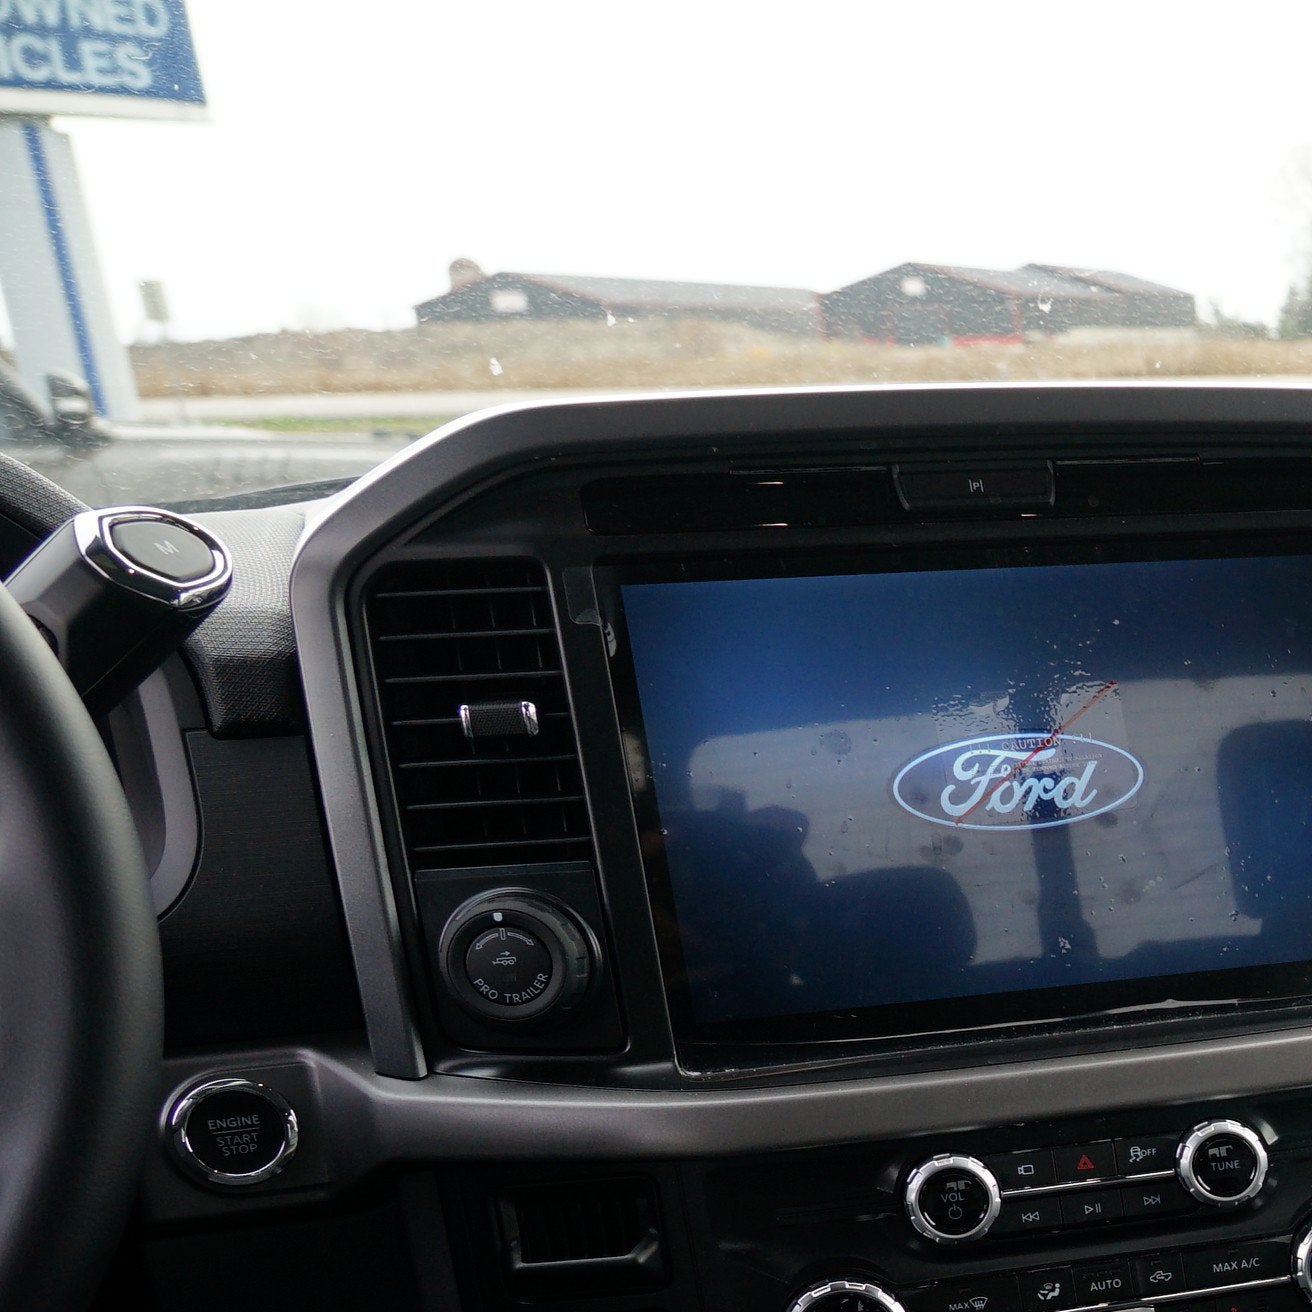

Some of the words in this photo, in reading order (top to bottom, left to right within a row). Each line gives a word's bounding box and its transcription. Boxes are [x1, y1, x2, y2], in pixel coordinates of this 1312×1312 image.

[0, 0, 170, 38] WNED
[1001, 737, 1062, 751] CAUTION
[940, 747, 1098, 818] Ford
[473, 978, 499, 1000] PRO
[504, 972, 549, 1004] TRAILER
[207, 1114, 261, 1131] ENGINE
[216, 1132, 260, 1147] START
[222, 1143, 258, 1157] STOP
[1140, 1146, 1157, 1157] OFF
[1210, 1159, 1241, 1172] TUNE
[941, 1191, 965, 1203] VOL
[1213, 1260, 1237, 1273] MAX
[1239, 1257, 1261, 1270] A/C
[1090, 1278, 1122, 1292] AUTO
[949, 1300, 970, 1311] MAX
